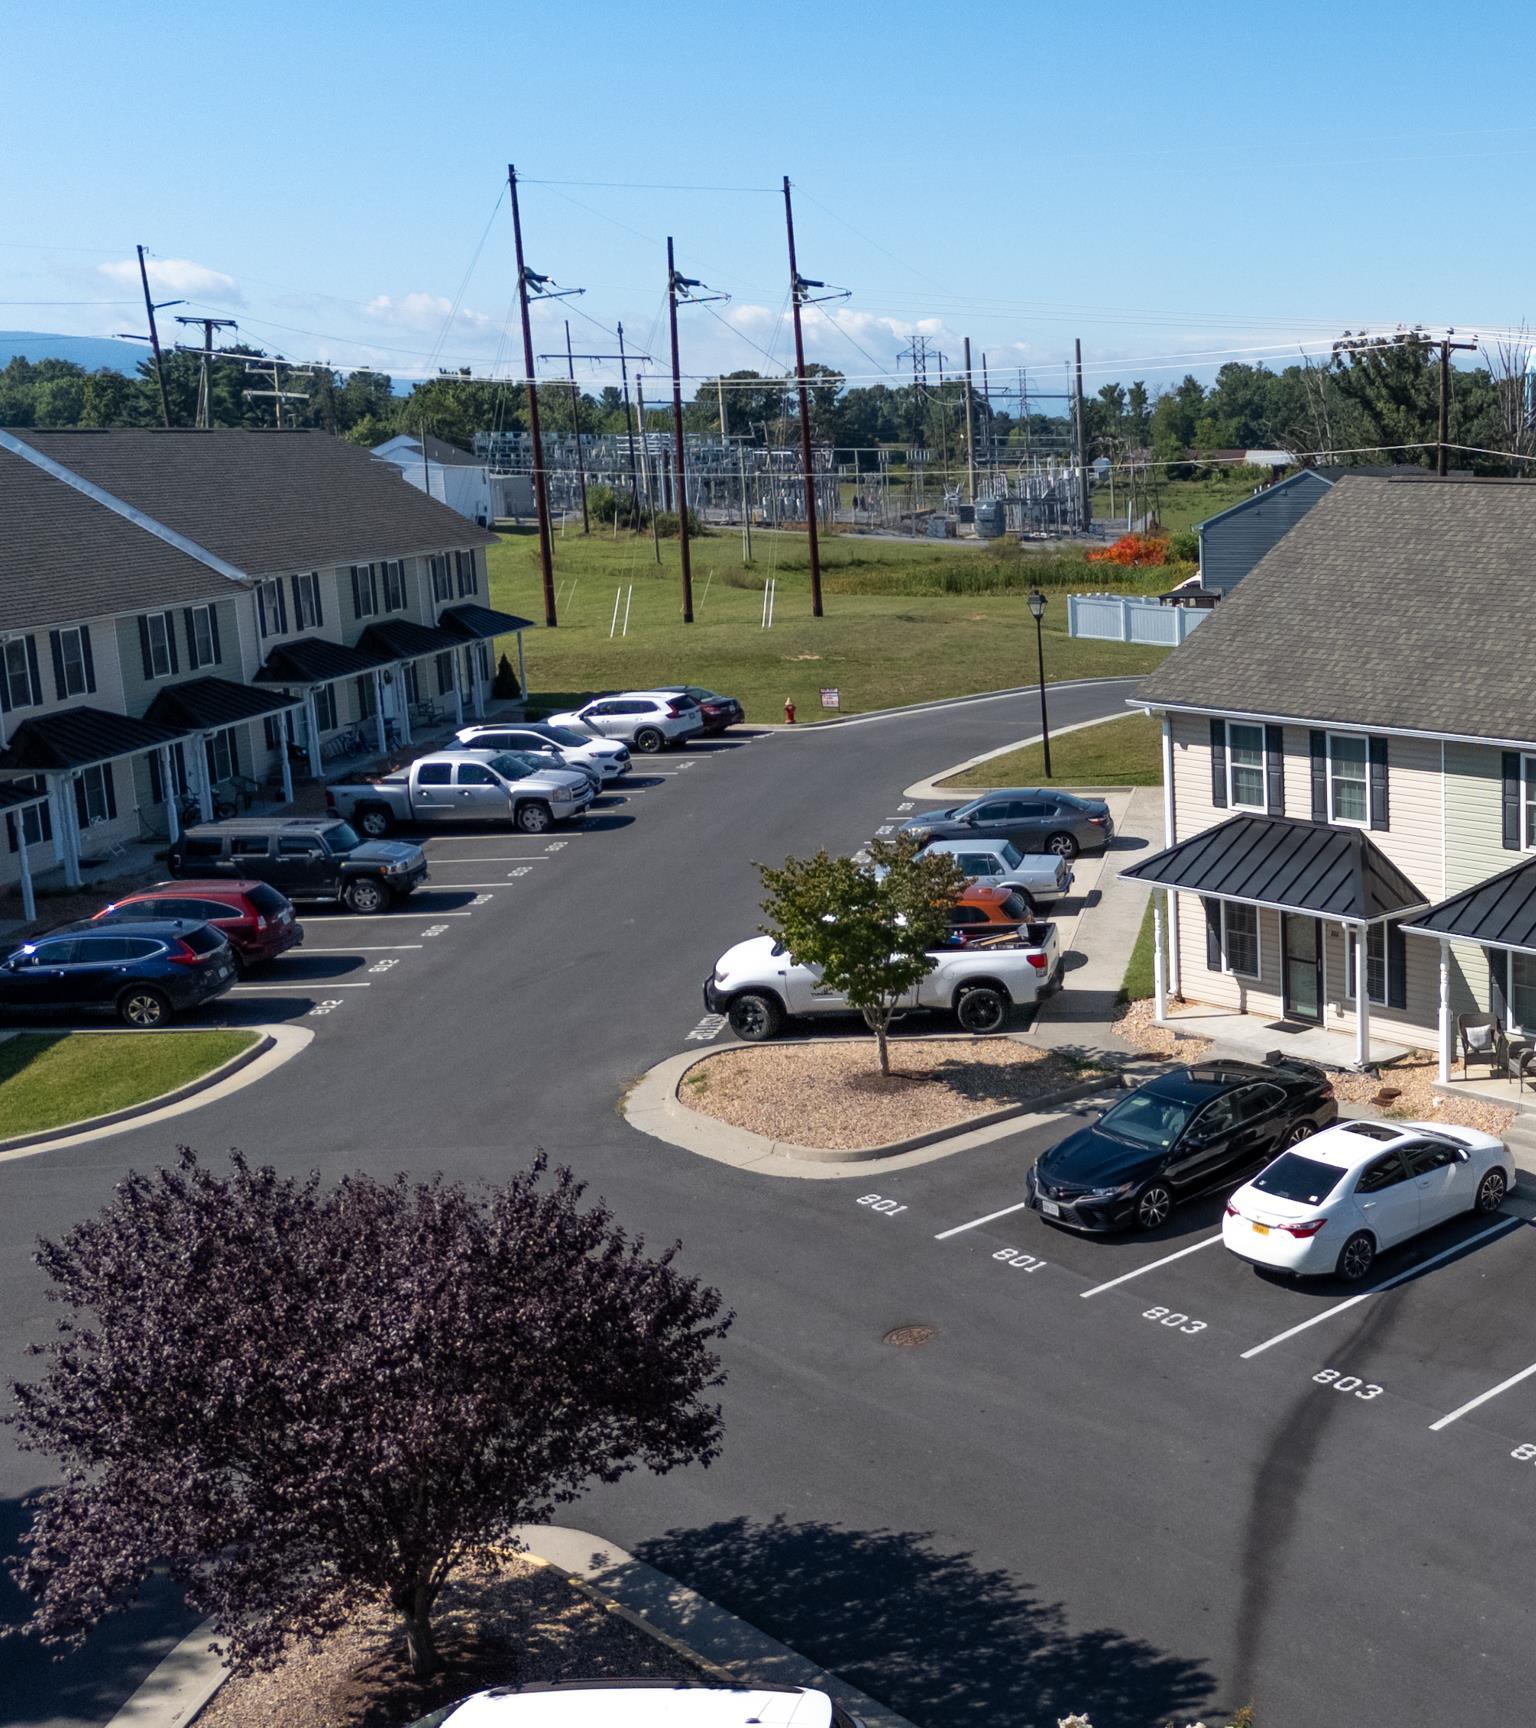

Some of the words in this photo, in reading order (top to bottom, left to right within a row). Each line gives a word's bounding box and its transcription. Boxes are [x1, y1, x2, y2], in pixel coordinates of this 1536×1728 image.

[368, 959, 400, 973] 812
[309, 999, 344, 1016] 812
[856, 1193, 908, 1217] 801
[991, 1248, 1047, 1273] 801
[1141, 1306, 1208, 1334] 803
[1312, 1369, 1384, 1400] 803
